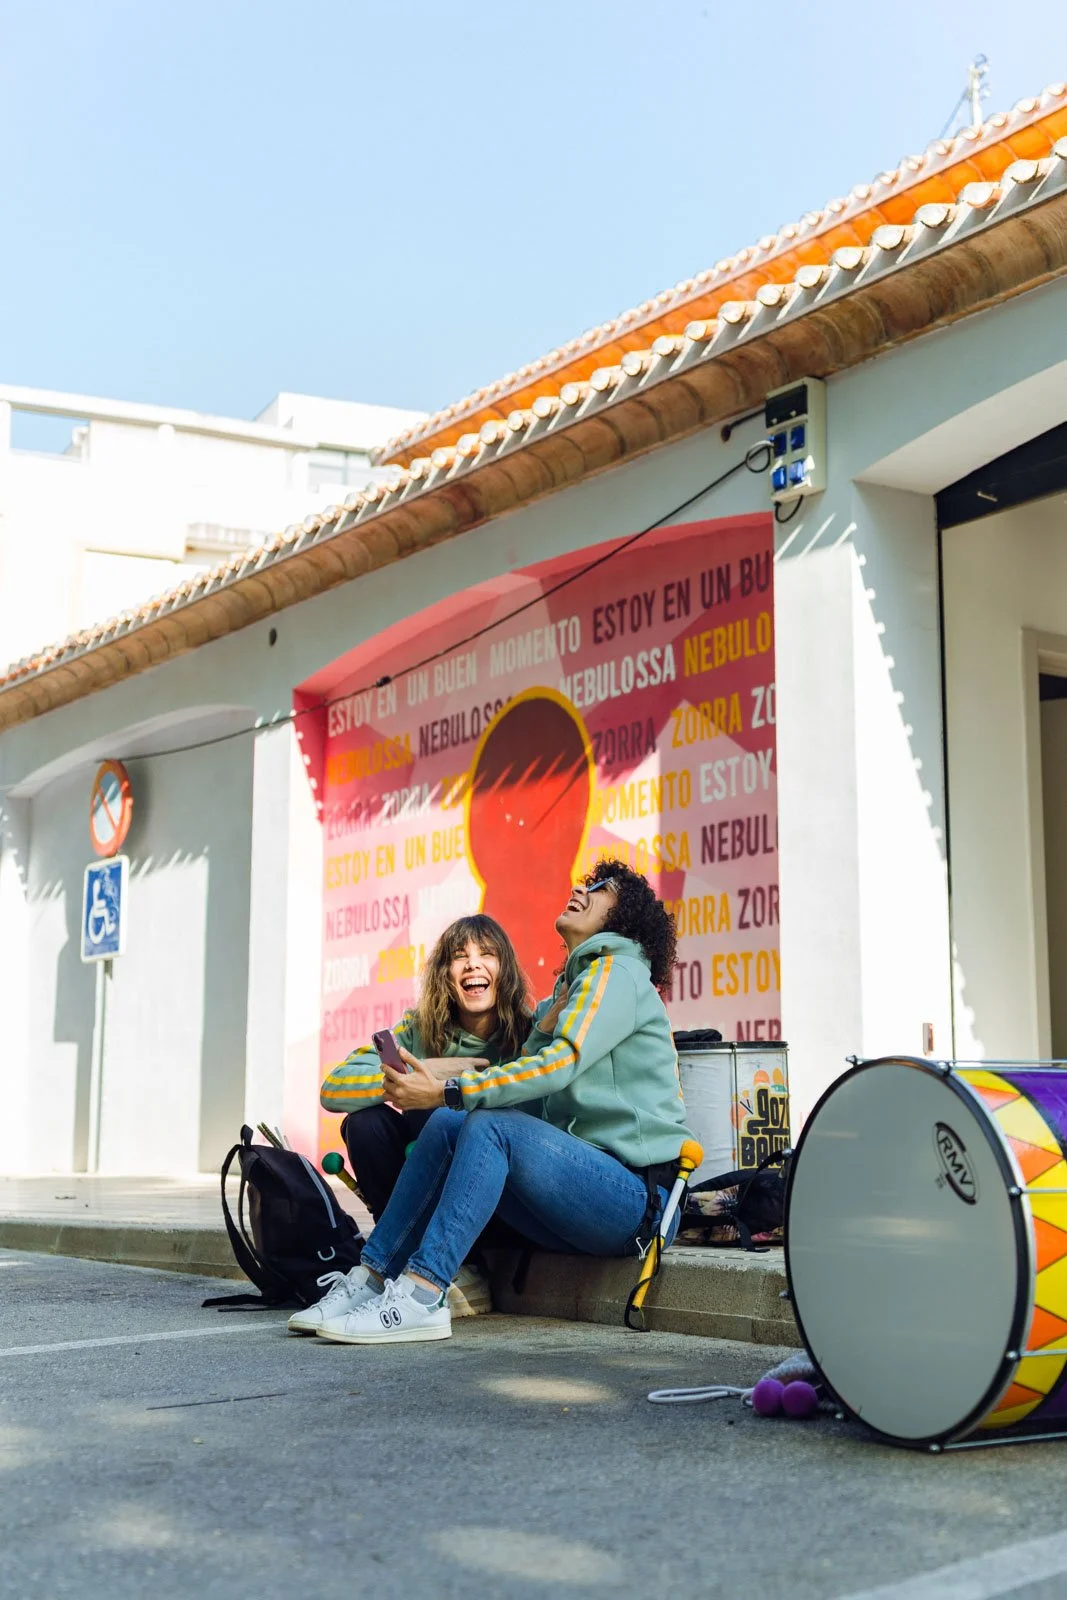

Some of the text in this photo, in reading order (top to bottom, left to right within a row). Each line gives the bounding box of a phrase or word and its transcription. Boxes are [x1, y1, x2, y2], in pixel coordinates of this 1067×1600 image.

[328, 550, 770, 737] ESTOY EN UN BUEN MOMENTO ESTOY EN UN BU
[559, 643, 676, 709] NEBULOSSA
[683, 611, 772, 678] NEBULO
[671, 693, 743, 749] ZORRA
[326, 849, 371, 890] ESTOY
[376, 843, 395, 879] EN
[404, 832, 427, 871] UN
[700, 748, 773, 805] ESTOY
[326, 894, 411, 942] NEBULOSSA
[701, 814, 779, 866] NEBUL
[738, 884, 780, 930] ZOR
[711, 948, 781, 997] ESTOY
[939, 1135, 973, 1187] RMV
